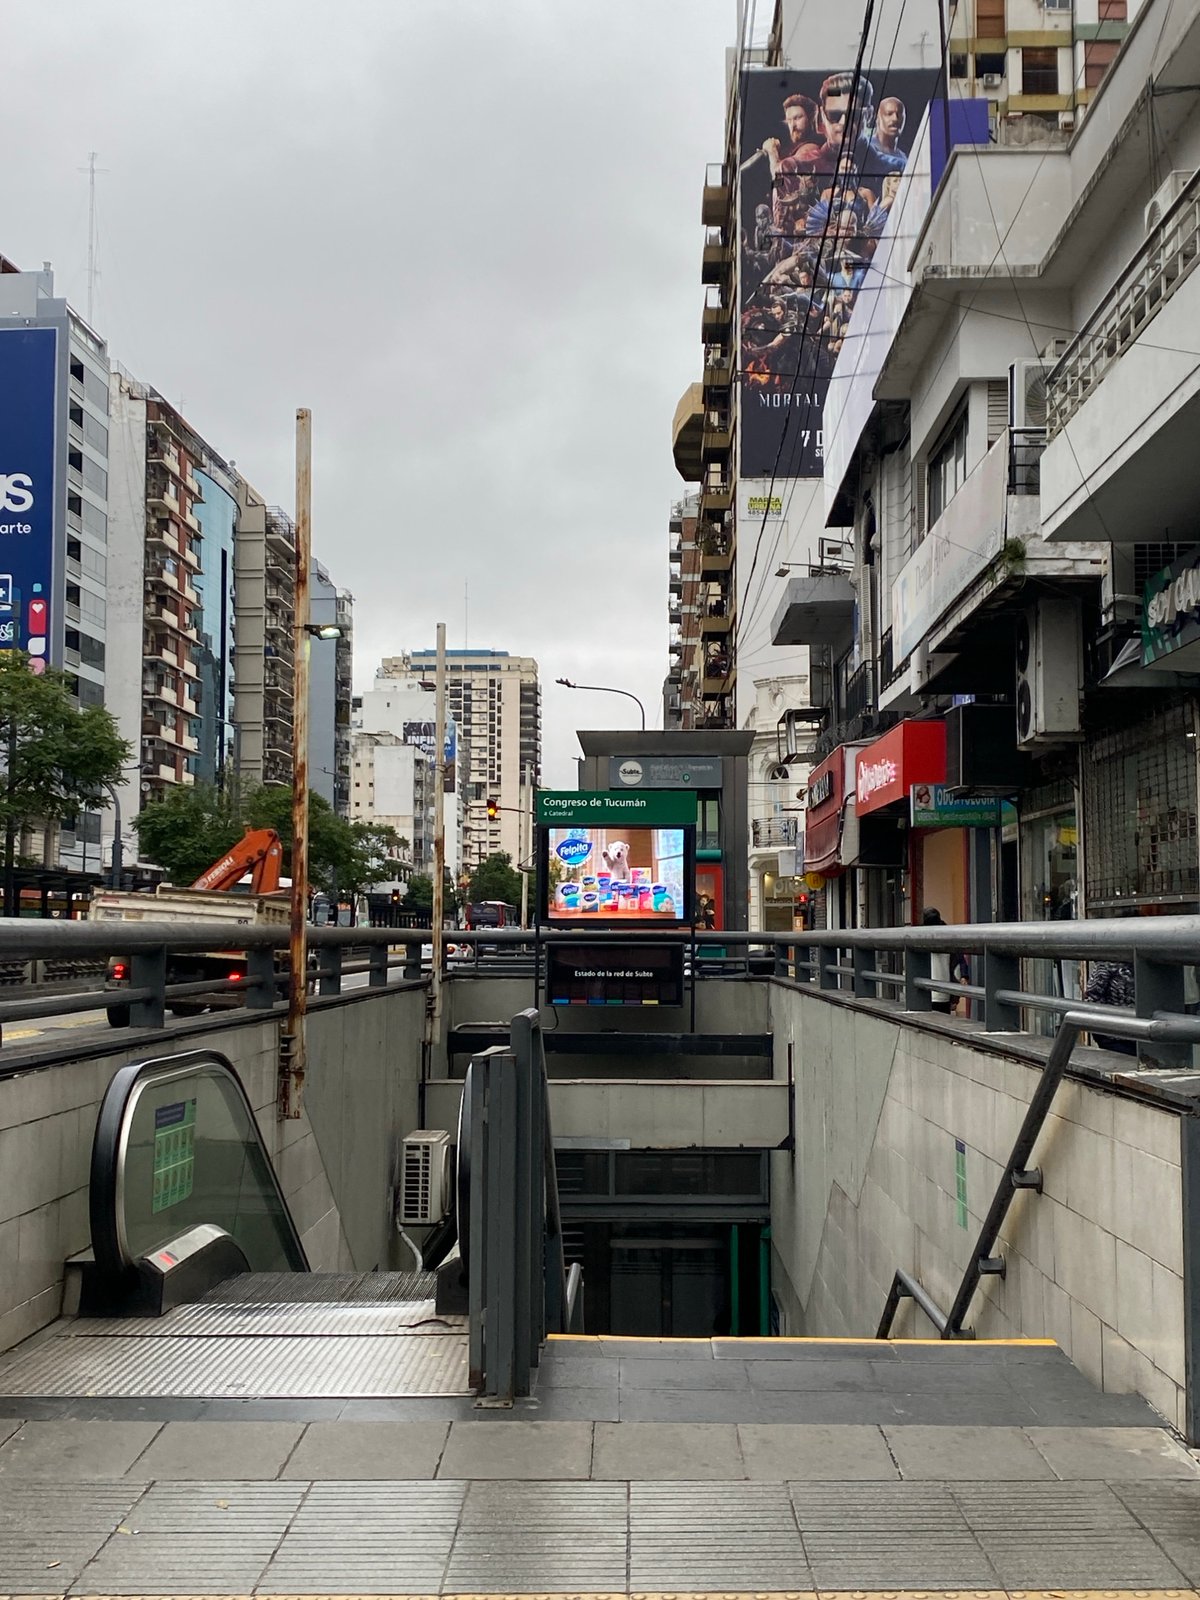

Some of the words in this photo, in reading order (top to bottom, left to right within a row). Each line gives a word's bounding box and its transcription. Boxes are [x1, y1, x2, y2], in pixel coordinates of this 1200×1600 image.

[760, 393, 820, 408] MORTAL
[801, 430, 811, 447] 7
[407, 735, 452, 745] INFINA
[543, 797, 588, 808] Congreso
[589, 797, 602, 807] de
[604, 797, 647, 807] Tucumán
[937, 788, 995, 805] ODOOLOGIA
[560, 843, 588, 856] Felpita
